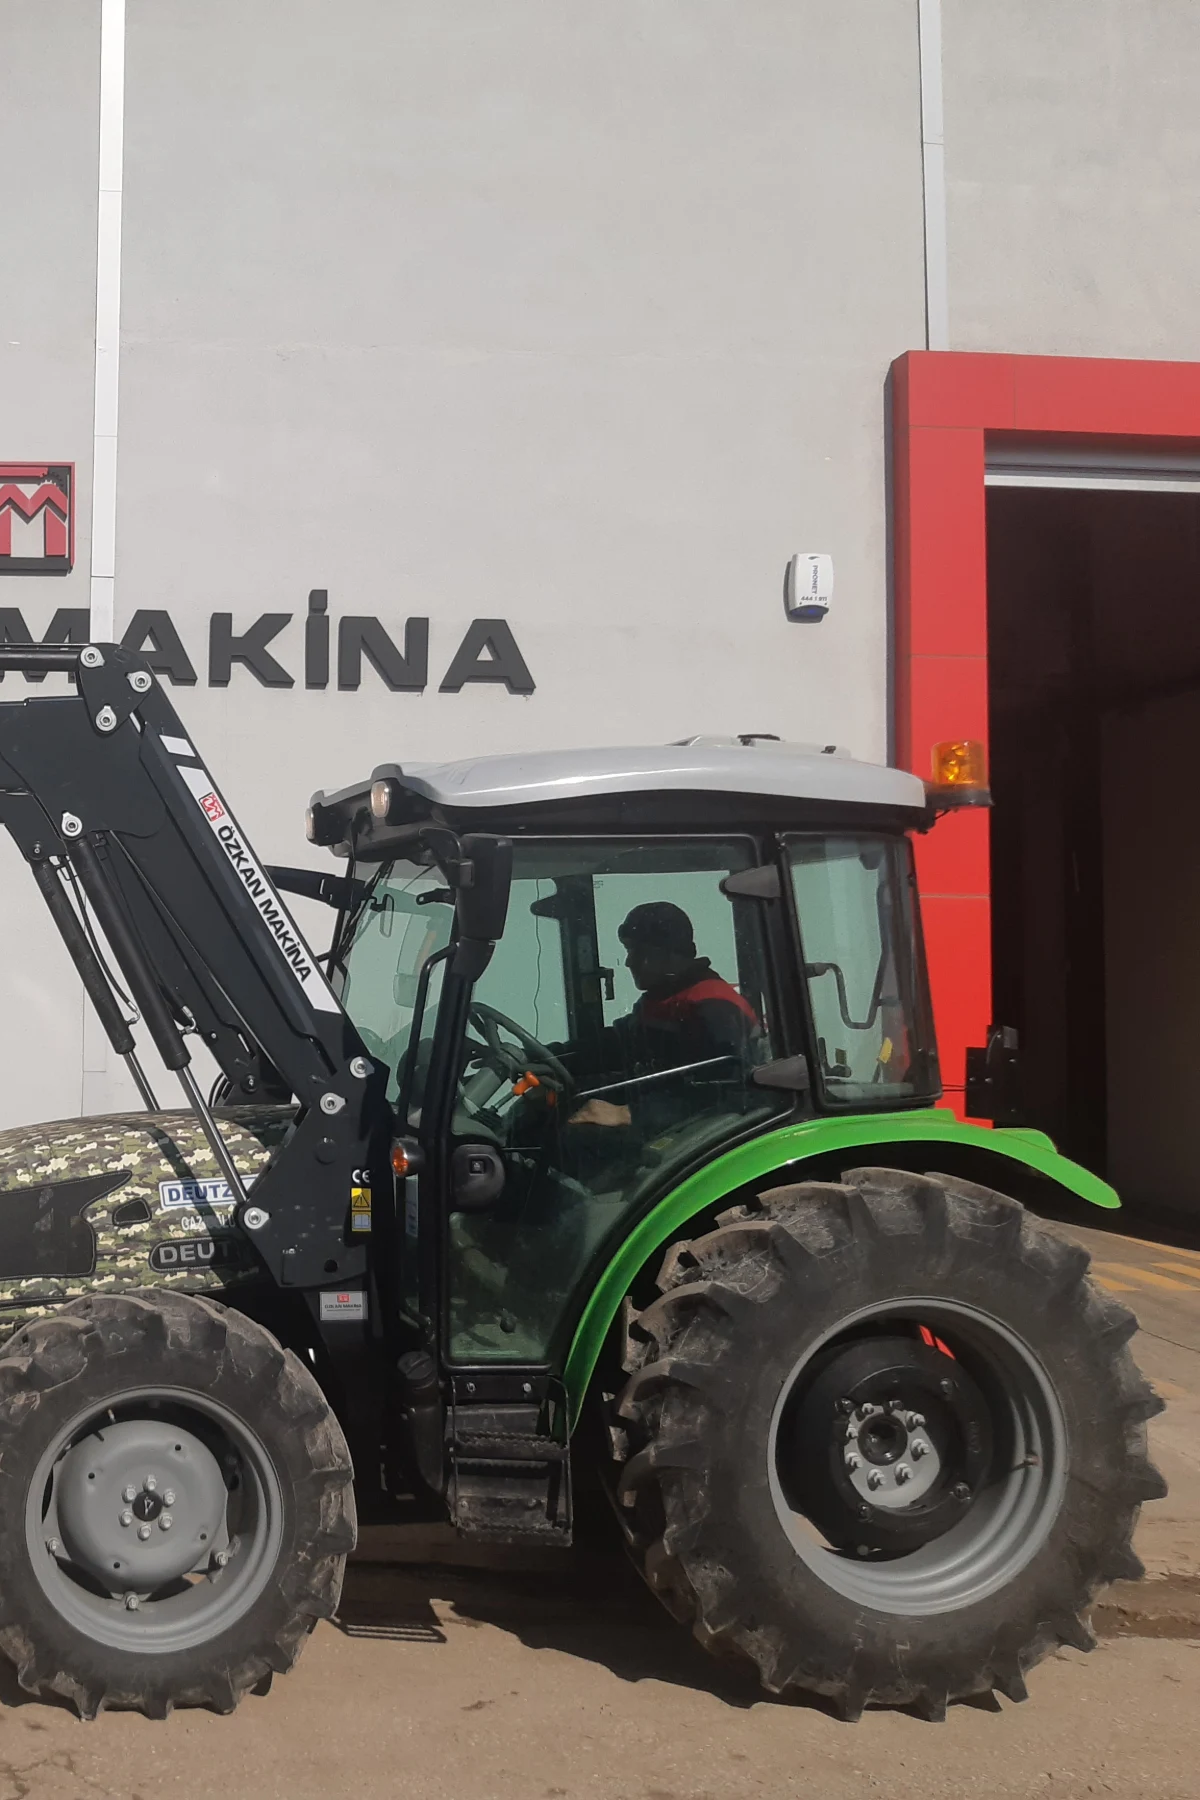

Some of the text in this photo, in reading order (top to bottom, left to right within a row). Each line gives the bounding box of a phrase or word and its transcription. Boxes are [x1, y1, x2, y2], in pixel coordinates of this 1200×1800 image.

[218, 825, 312, 983] ÖZKAN MAKİNA
[352, 1169, 370, 1184] CE
[167, 1183, 235, 1202] DEUTZ
